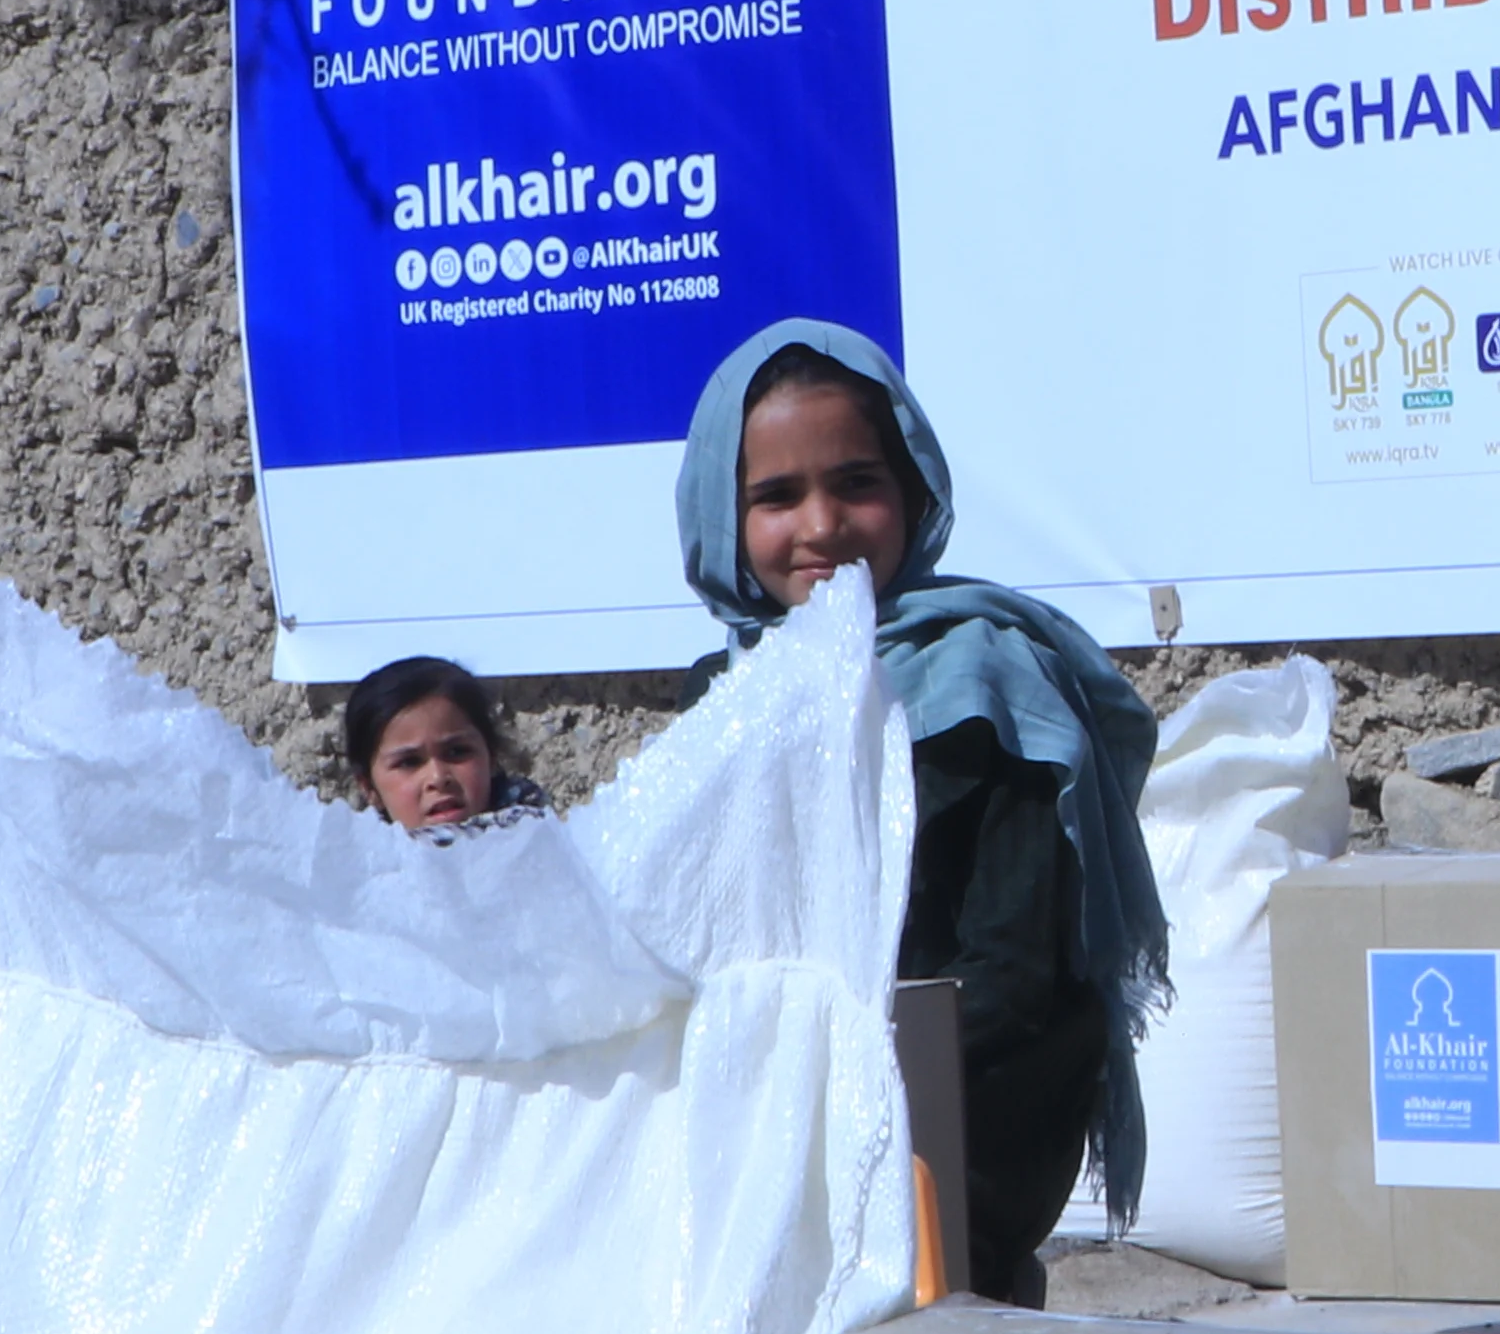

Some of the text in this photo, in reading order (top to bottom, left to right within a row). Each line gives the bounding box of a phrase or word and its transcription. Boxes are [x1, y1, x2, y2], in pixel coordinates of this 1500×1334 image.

[313, 39, 439, 89] BALANCE
[447, 20, 581, 72] WITHOUT
[393, 151, 718, 230] alkhair.org
[572, 229, 720, 271] @AlKhairUK
[1389, 251, 1453, 274] WATCH
[1458, 248, 1492, 267] LIVE
[400, 273, 720, 325] UK Registered Charity No 1126808
[1333, 418, 1357, 432] SKY
[1405, 413, 1427, 427] SKY
[1346, 443, 1439, 466] www.iqra.tv
[1384, 1032, 1488, 1057] Al-Khair
[1384, 1058, 1489, 1072] FOUNDATION
